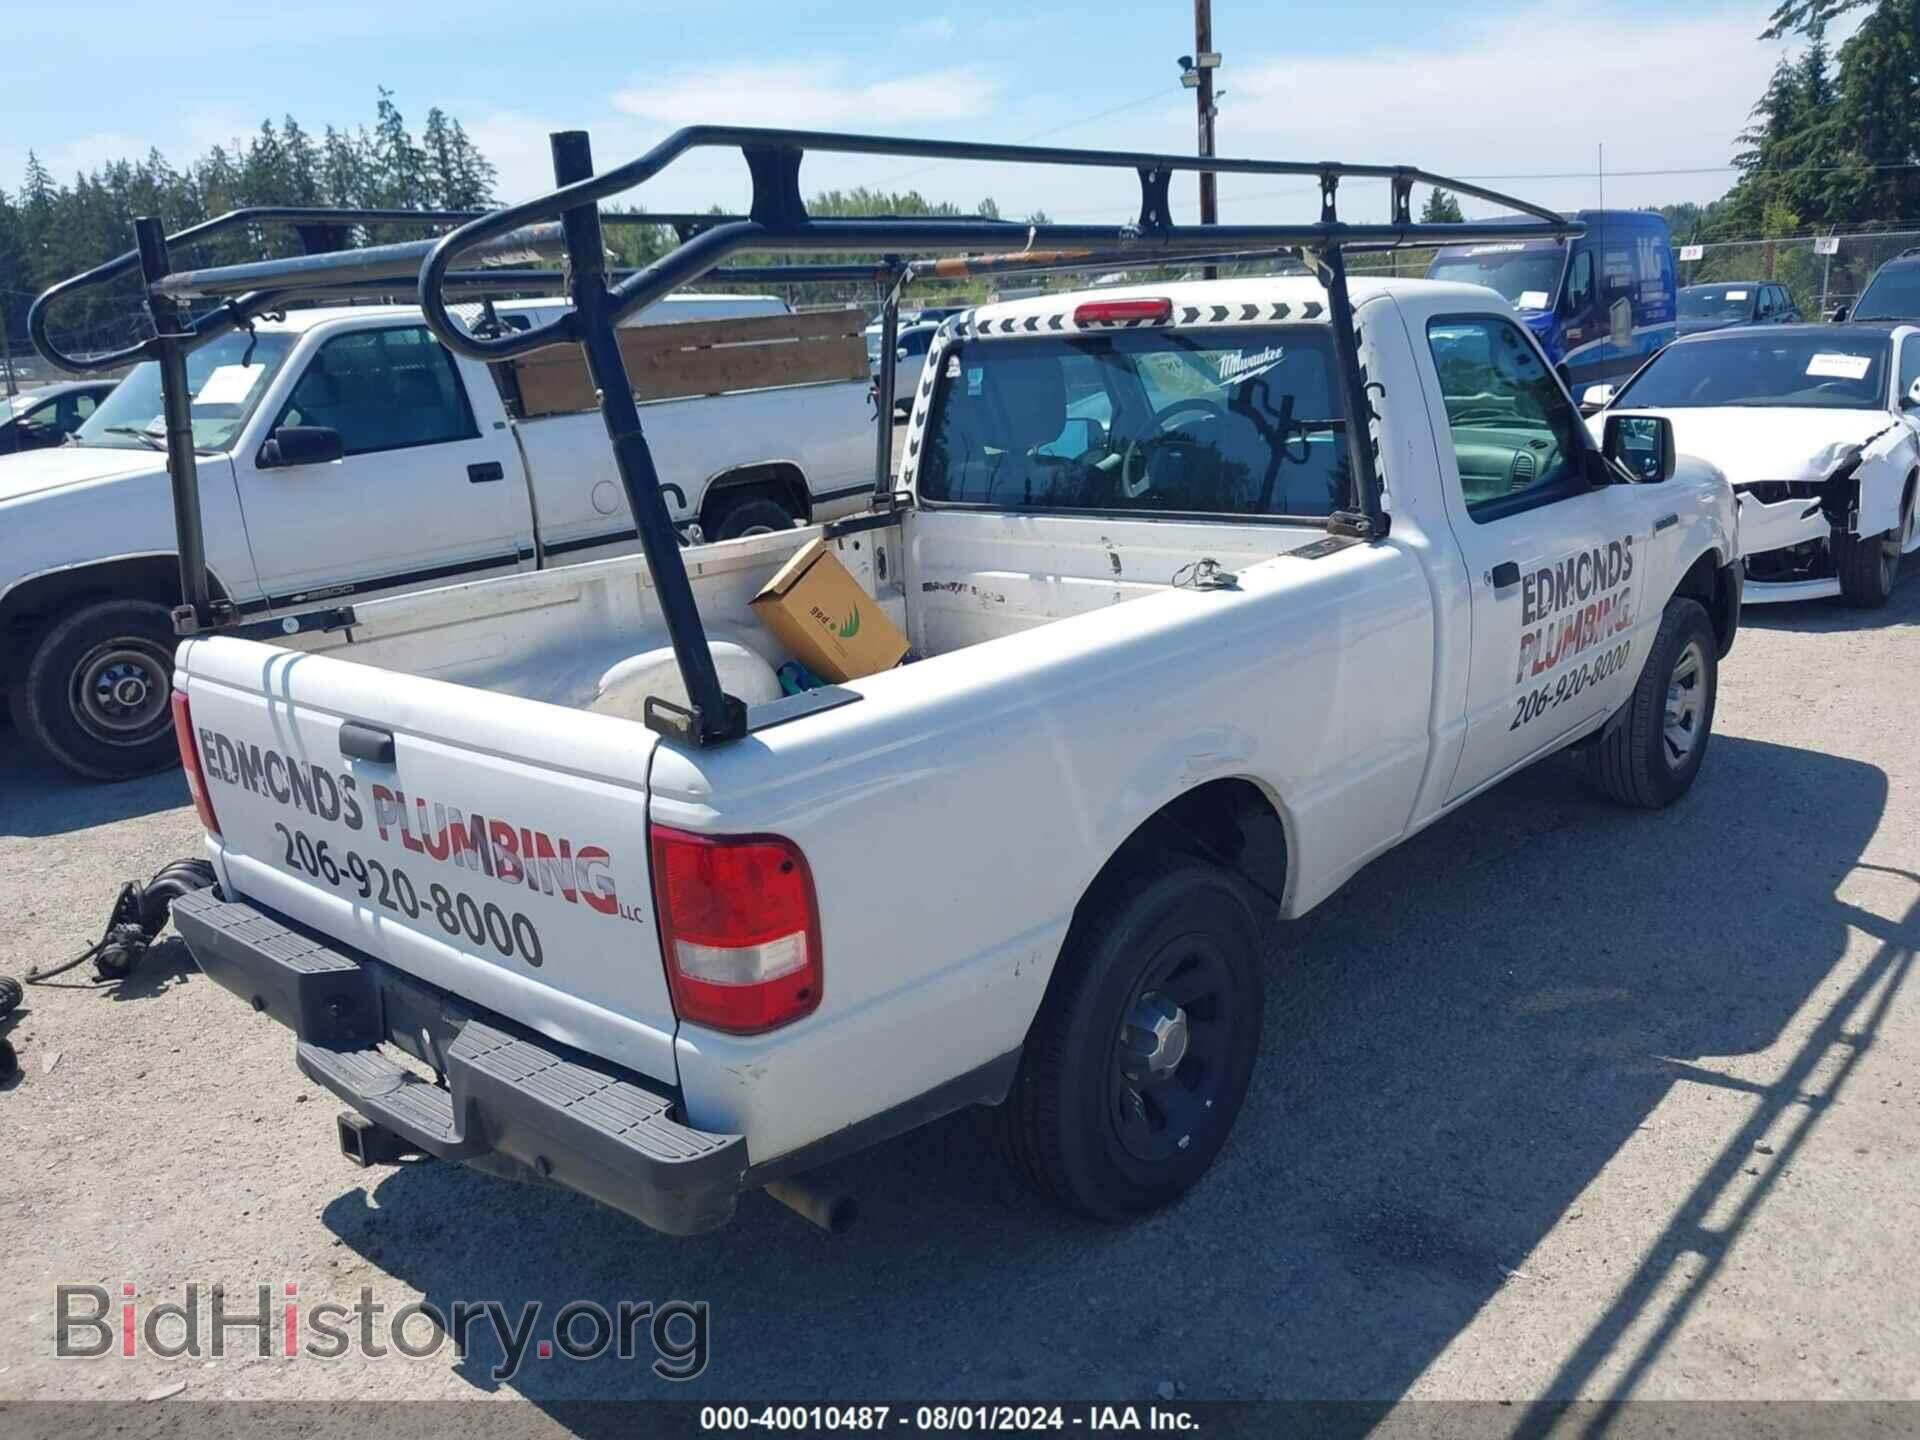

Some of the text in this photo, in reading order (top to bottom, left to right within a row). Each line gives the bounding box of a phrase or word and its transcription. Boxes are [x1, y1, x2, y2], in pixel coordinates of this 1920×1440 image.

[1217, 345, 1285, 379] Milwaukee
[1509, 640, 1631, 731] 206-920-8000
[199, 728, 643, 924] EDMONDS PLUMBING LLC
[275, 822, 543, 968] 206-920-8000
